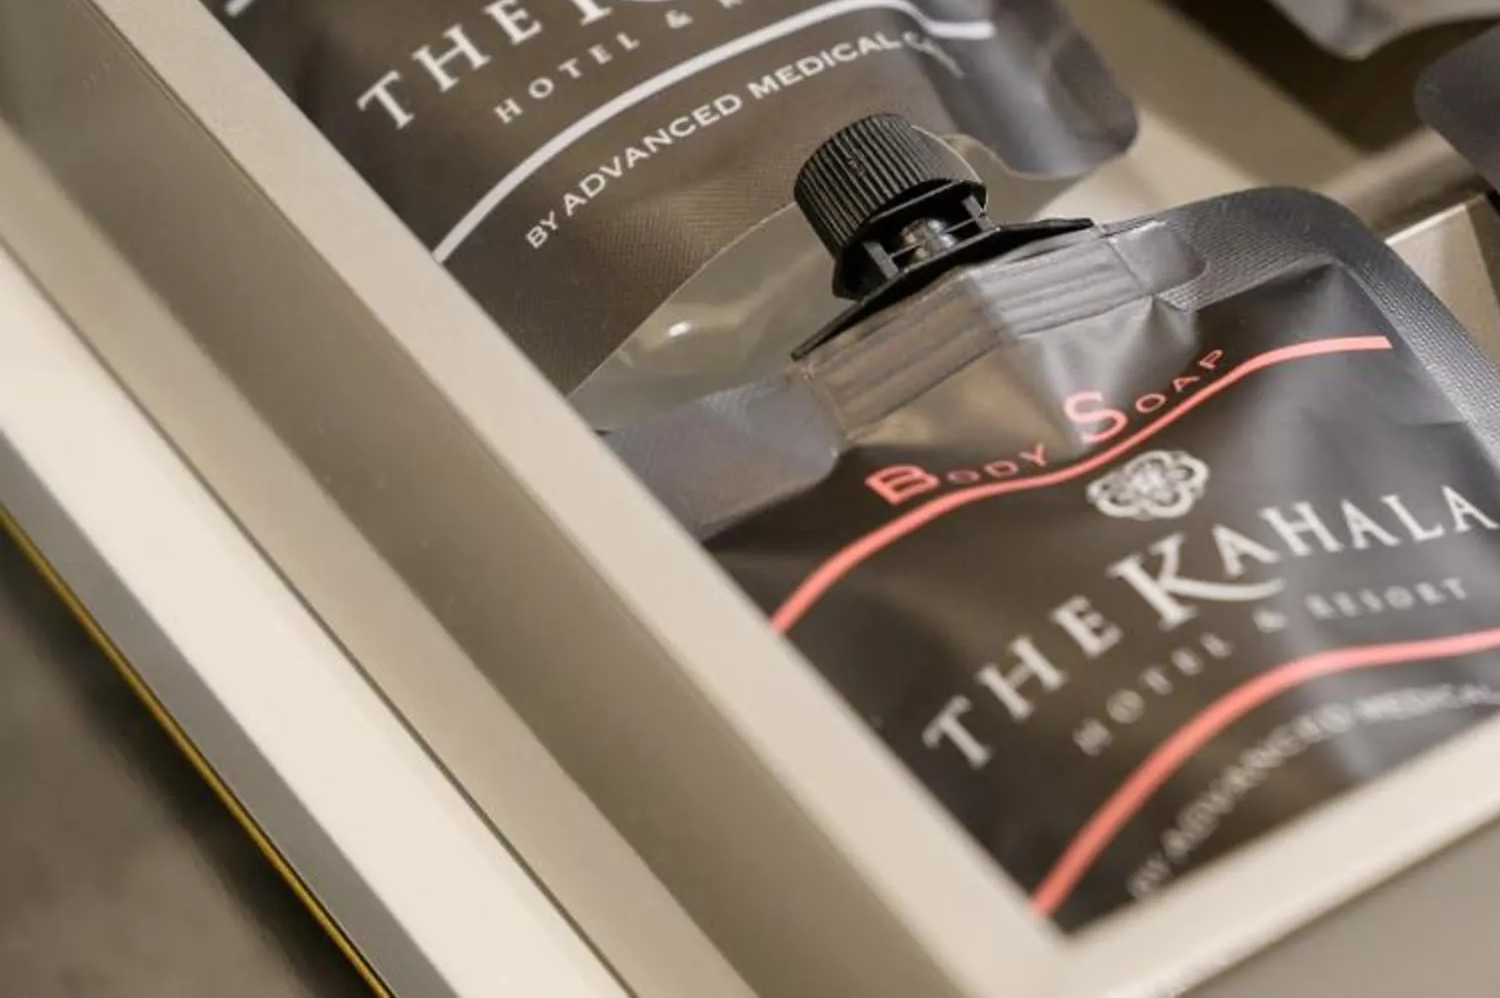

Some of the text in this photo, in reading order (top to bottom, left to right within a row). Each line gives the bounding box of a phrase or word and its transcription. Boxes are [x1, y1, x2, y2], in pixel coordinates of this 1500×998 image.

[493, 31, 640, 124] HOTEL
[664, 9, 694, 30] &
[525, 194, 570, 250] BY
[561, 92, 744, 217] ADVANCED
[747, 30, 905, 100] MEDICAL
[866, 348, 1224, 505] BODY SOAP
[1304, 576, 1468, 621] RESORT
[922, 594, 1123, 771] THE
